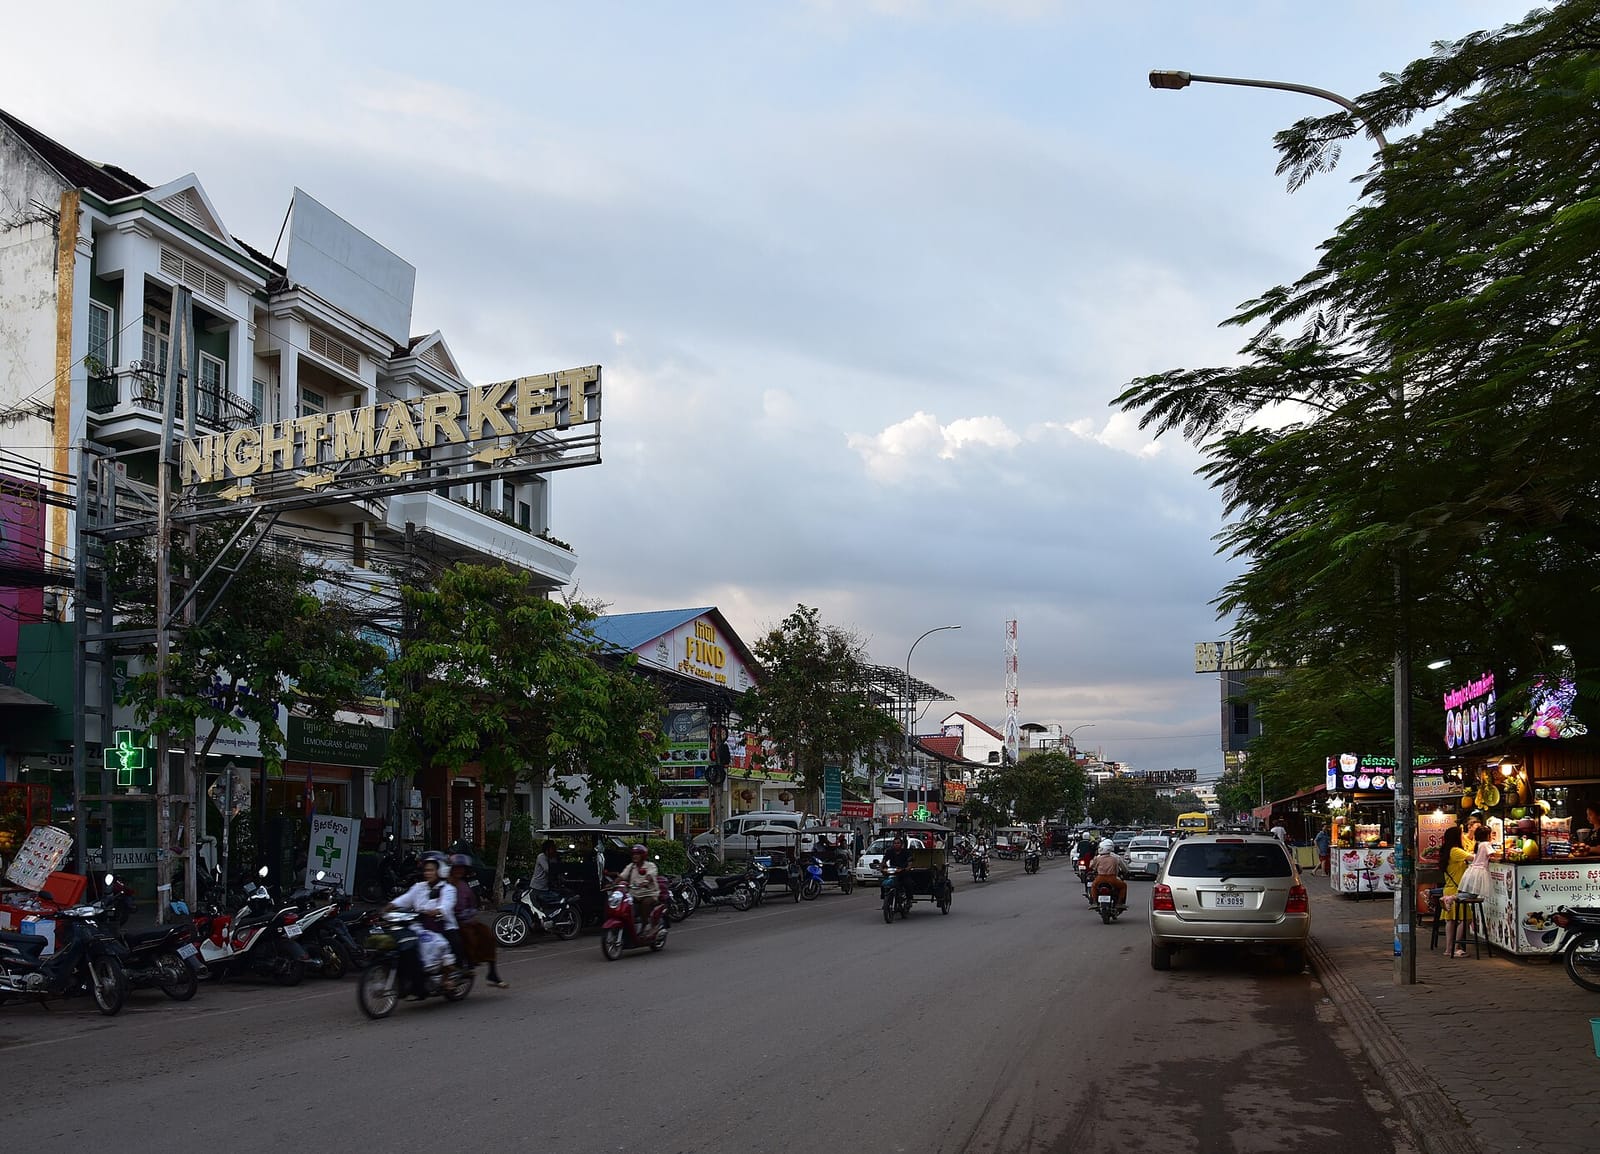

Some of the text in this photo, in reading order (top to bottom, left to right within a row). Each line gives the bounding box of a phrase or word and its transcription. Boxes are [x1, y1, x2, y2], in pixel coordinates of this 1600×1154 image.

[686, 637, 727, 669] FIND
[303, 736, 368, 751] LEMONGRASS GARDEN
[1541, 883, 1583, 892] Welcome
